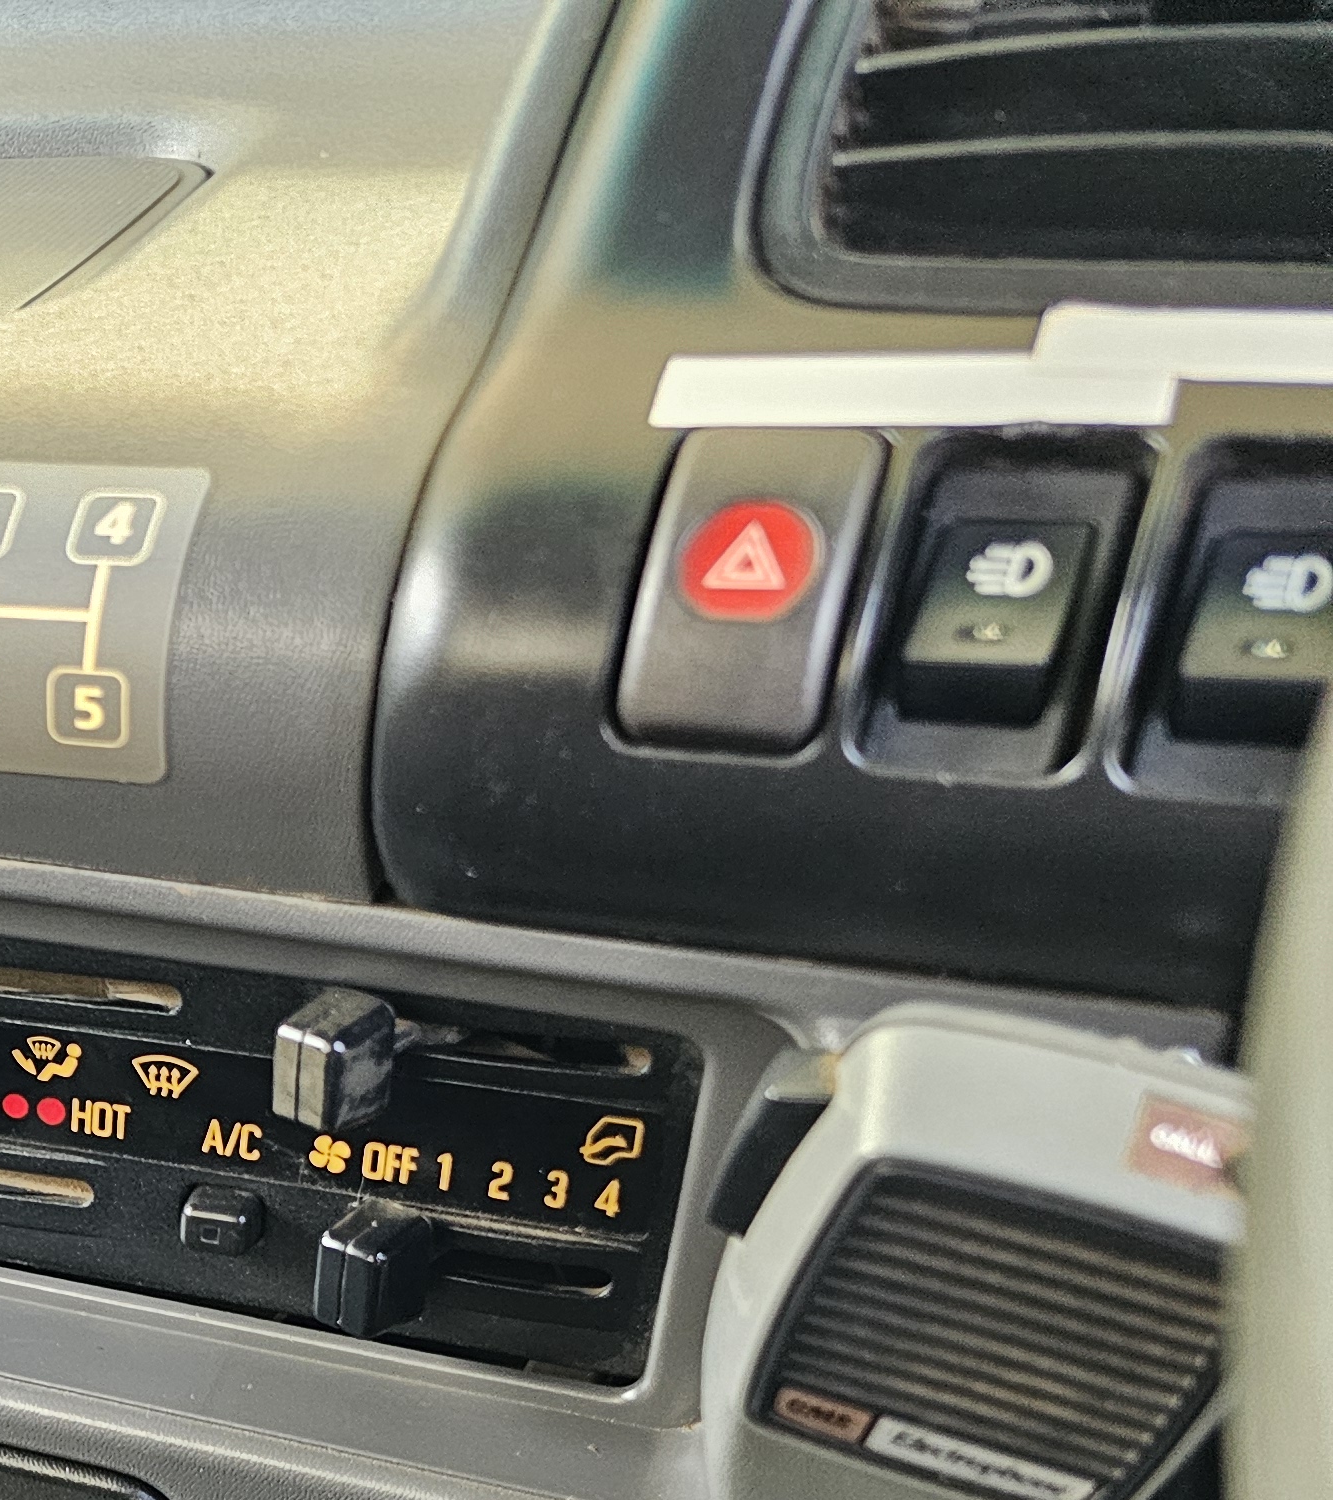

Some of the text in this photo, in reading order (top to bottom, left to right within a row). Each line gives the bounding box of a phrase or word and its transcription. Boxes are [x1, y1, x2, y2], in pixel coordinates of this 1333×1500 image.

[93, 501, 136, 545] 4
[73, 685, 105, 732] 5
[71, 1097, 132, 1140] HOT
[201, 1117, 264, 1162] A/C
[361, 1140, 622, 1218] OFF 1 2 3 4
